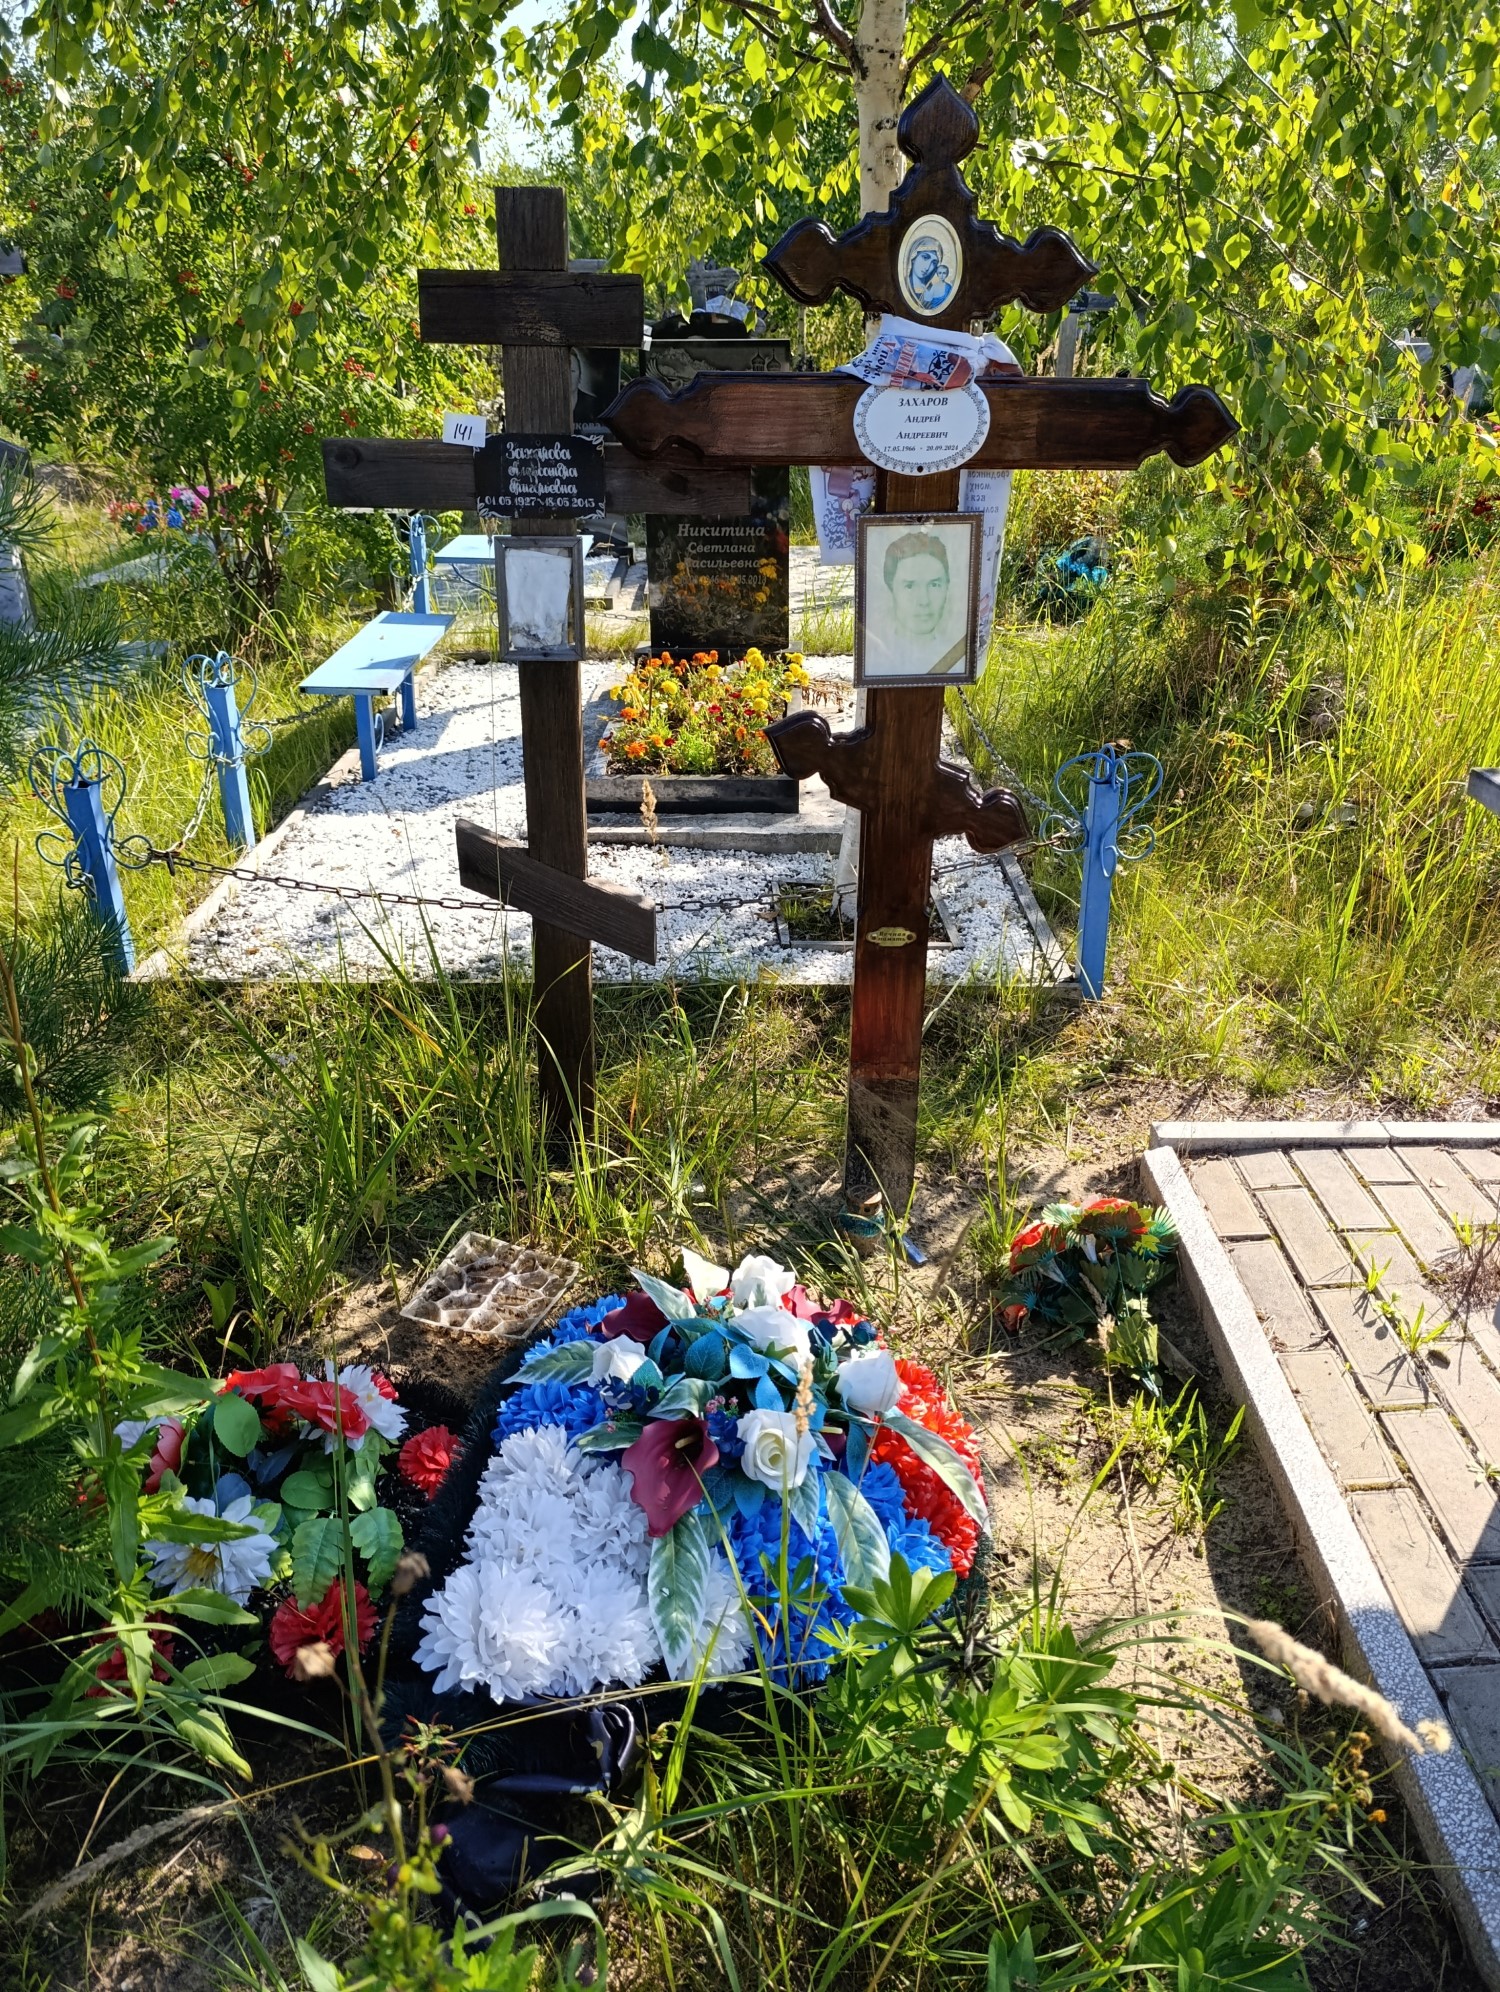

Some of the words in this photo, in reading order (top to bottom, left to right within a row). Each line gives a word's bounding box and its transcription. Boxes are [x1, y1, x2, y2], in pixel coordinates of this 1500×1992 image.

[897, 397, 949, 407] ЗАХАРОВ
[453, 423, 473, 441] 141
[677, 523, 766, 537] Никитина
[687, 542, 756, 553] Светлана
